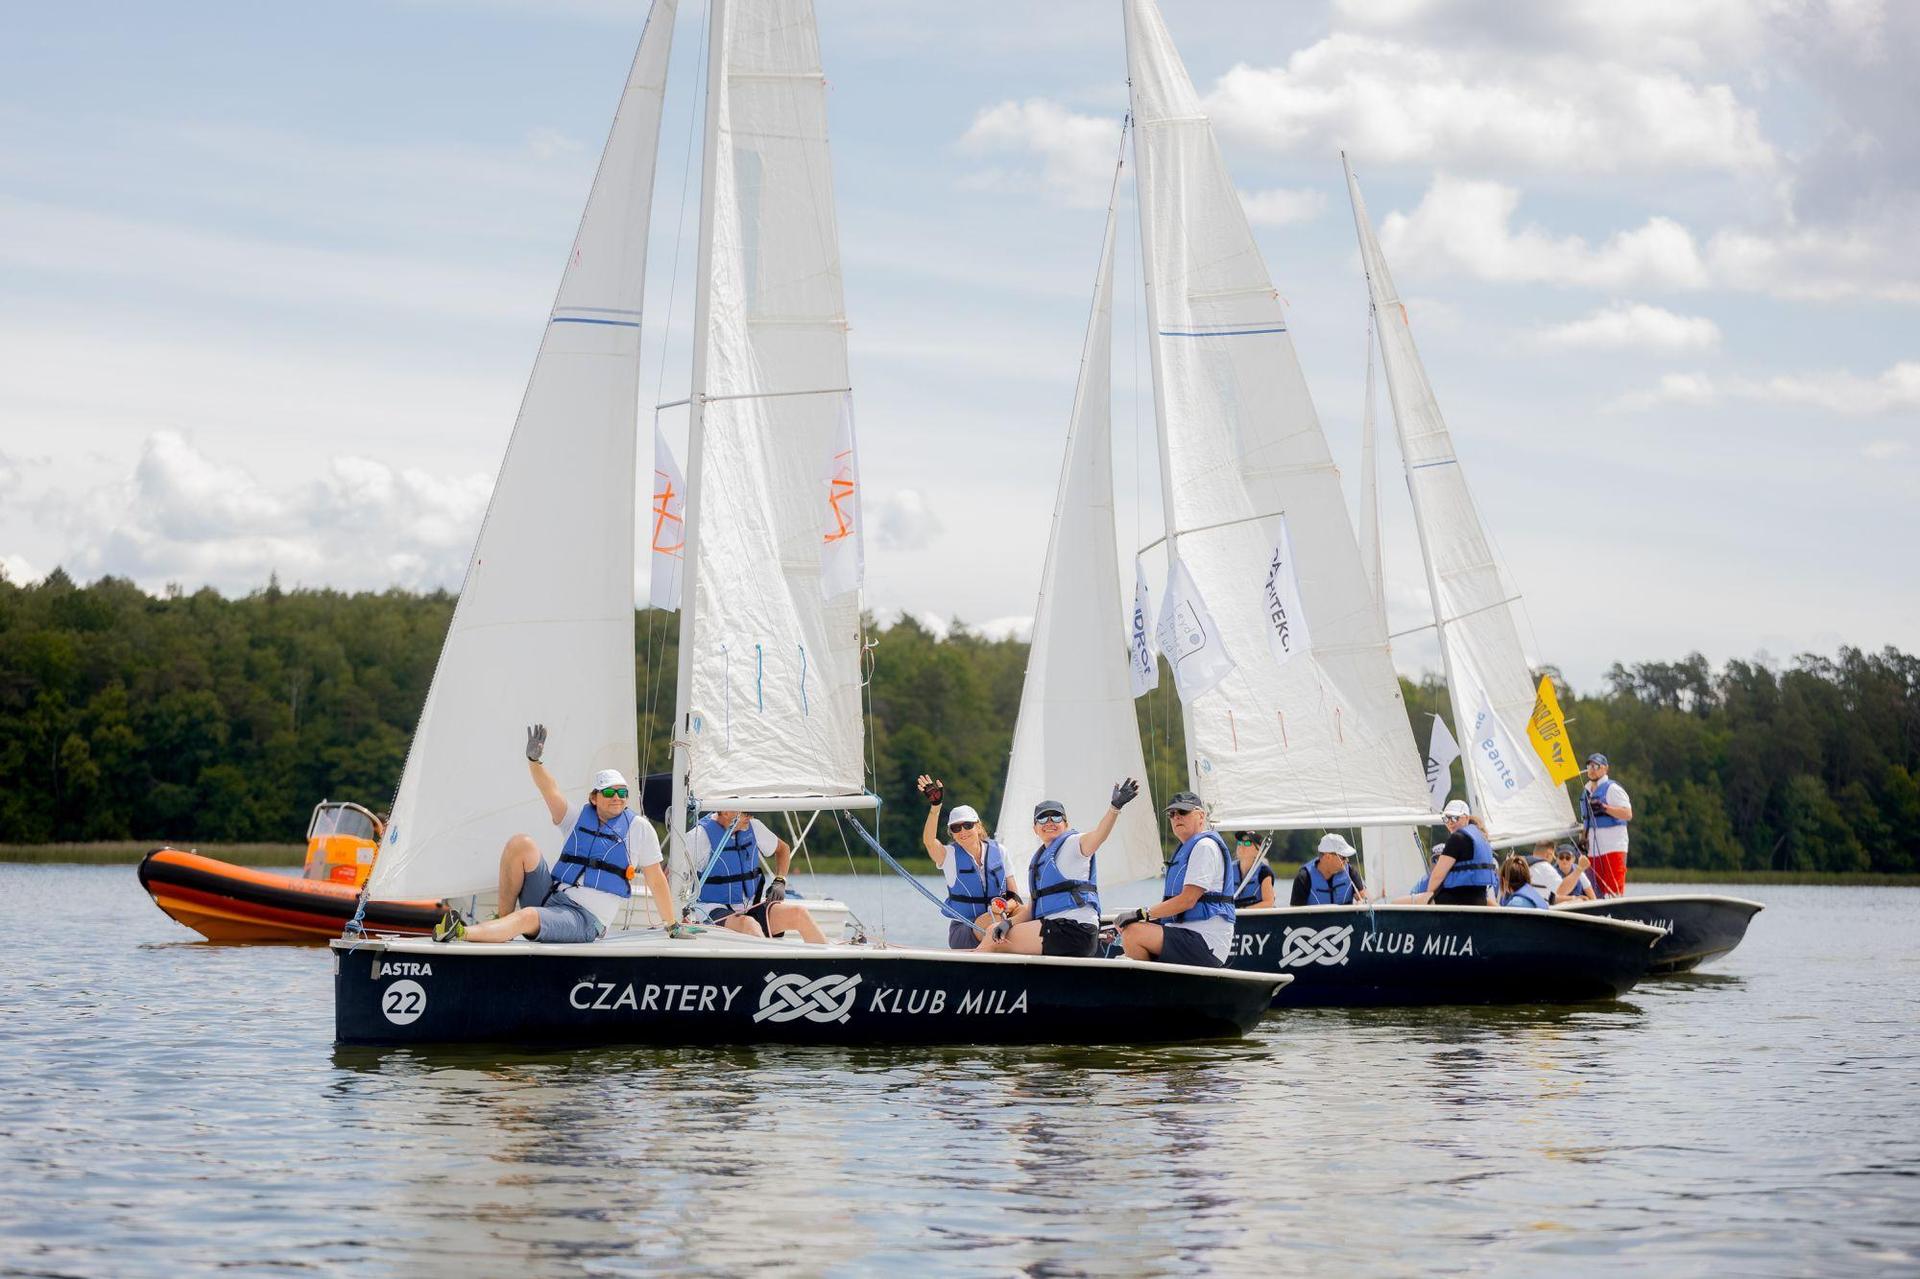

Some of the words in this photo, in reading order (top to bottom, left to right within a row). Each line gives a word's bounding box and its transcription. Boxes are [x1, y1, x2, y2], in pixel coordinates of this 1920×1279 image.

[1360, 931, 1415, 954] KLUB
[1422, 934, 1473, 956] MILA
[380, 962, 433, 977] ASTRA
[386, 990, 422, 1015] 22
[569, 981, 743, 1011] CZARTERY
[868, 988, 947, 1014] KLUB
[956, 989, 1028, 1014] MILA
